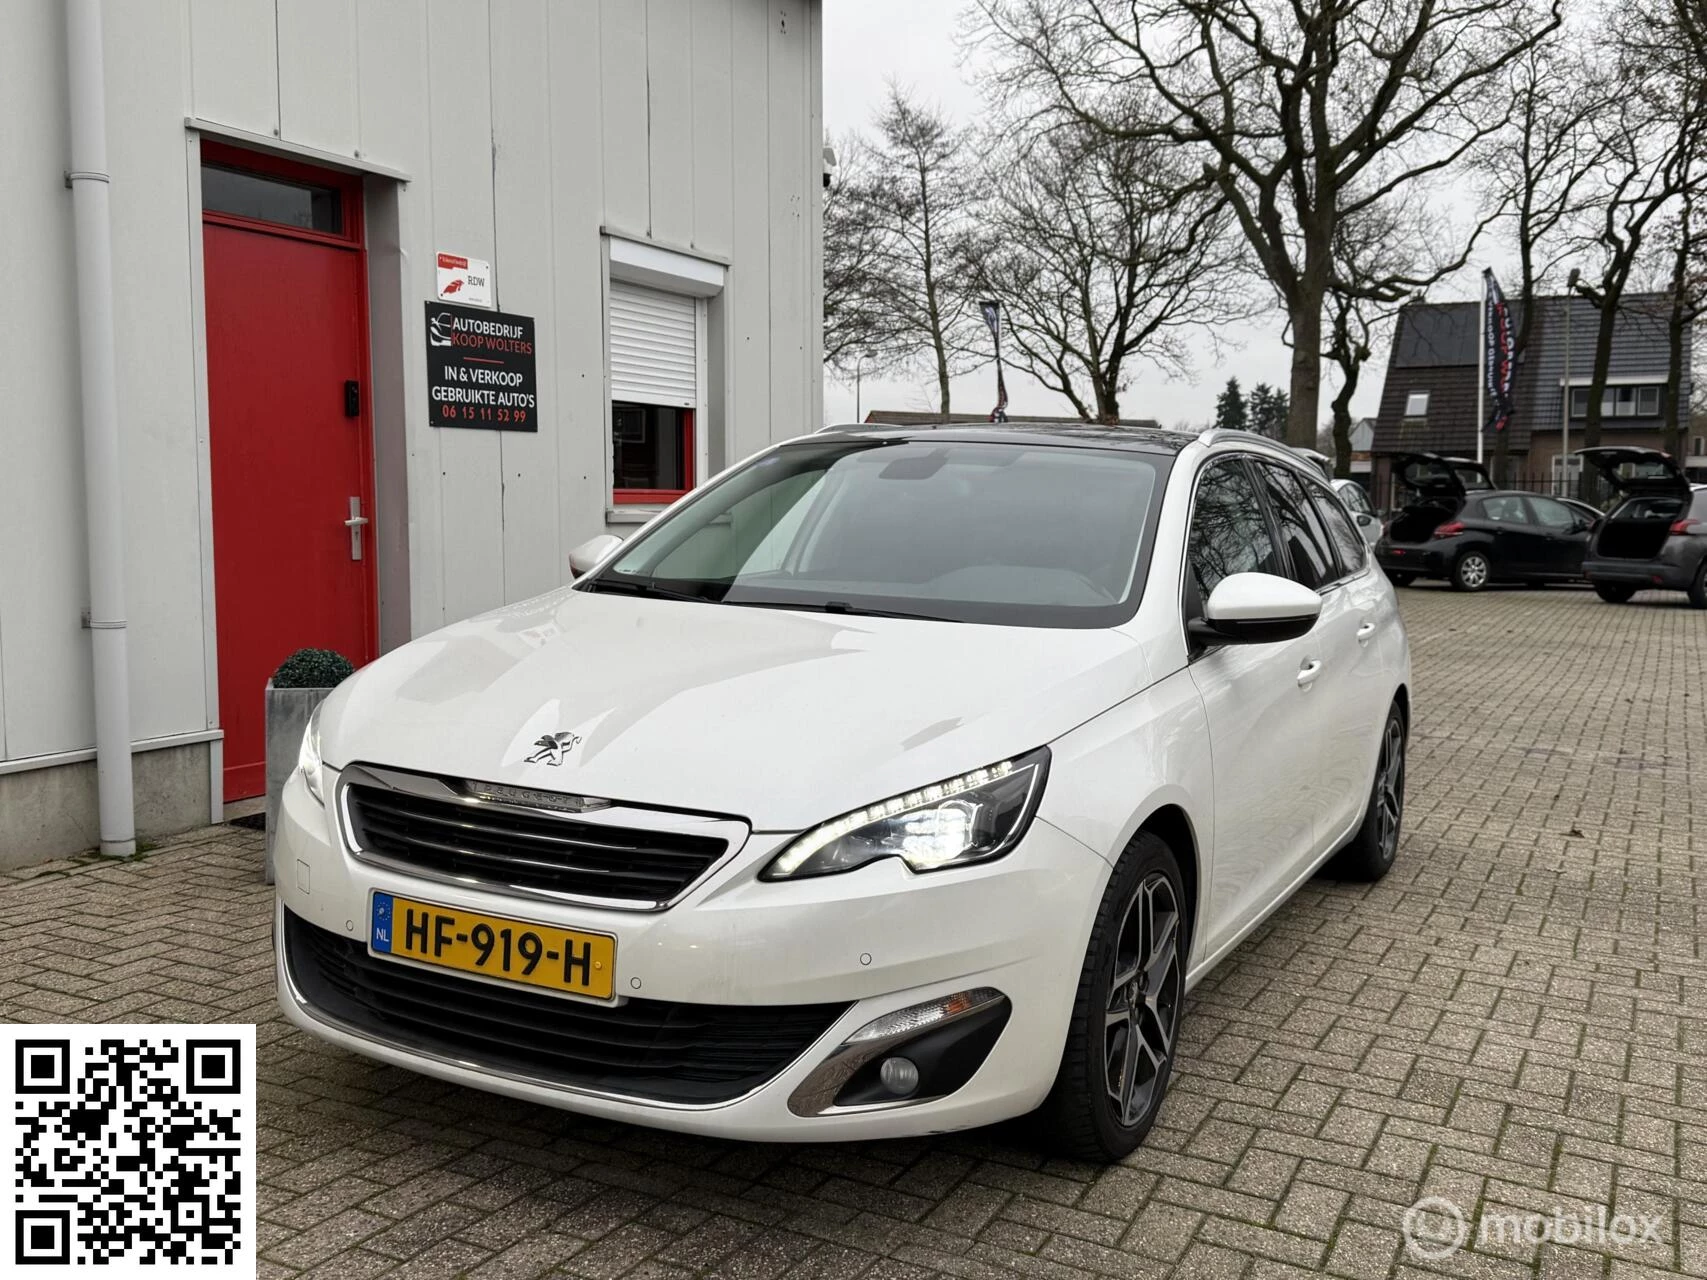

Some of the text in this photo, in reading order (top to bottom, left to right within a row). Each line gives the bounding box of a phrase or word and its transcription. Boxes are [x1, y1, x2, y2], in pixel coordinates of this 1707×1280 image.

[467, 275, 485, 288] RDW
[452, 317, 523, 338] AUTOBEDRIJF
[452, 333, 532, 354] KOOP WOLTERS
[444, 365, 523, 387] IN & VERKOOP
[432, 386, 535, 408] GEBRUIKTE AUTO'S
[442, 404, 526, 423] 06 15 11 52 99
[376, 927, 389, 943] NL
[406, 909, 591, 987] HF-919-H
